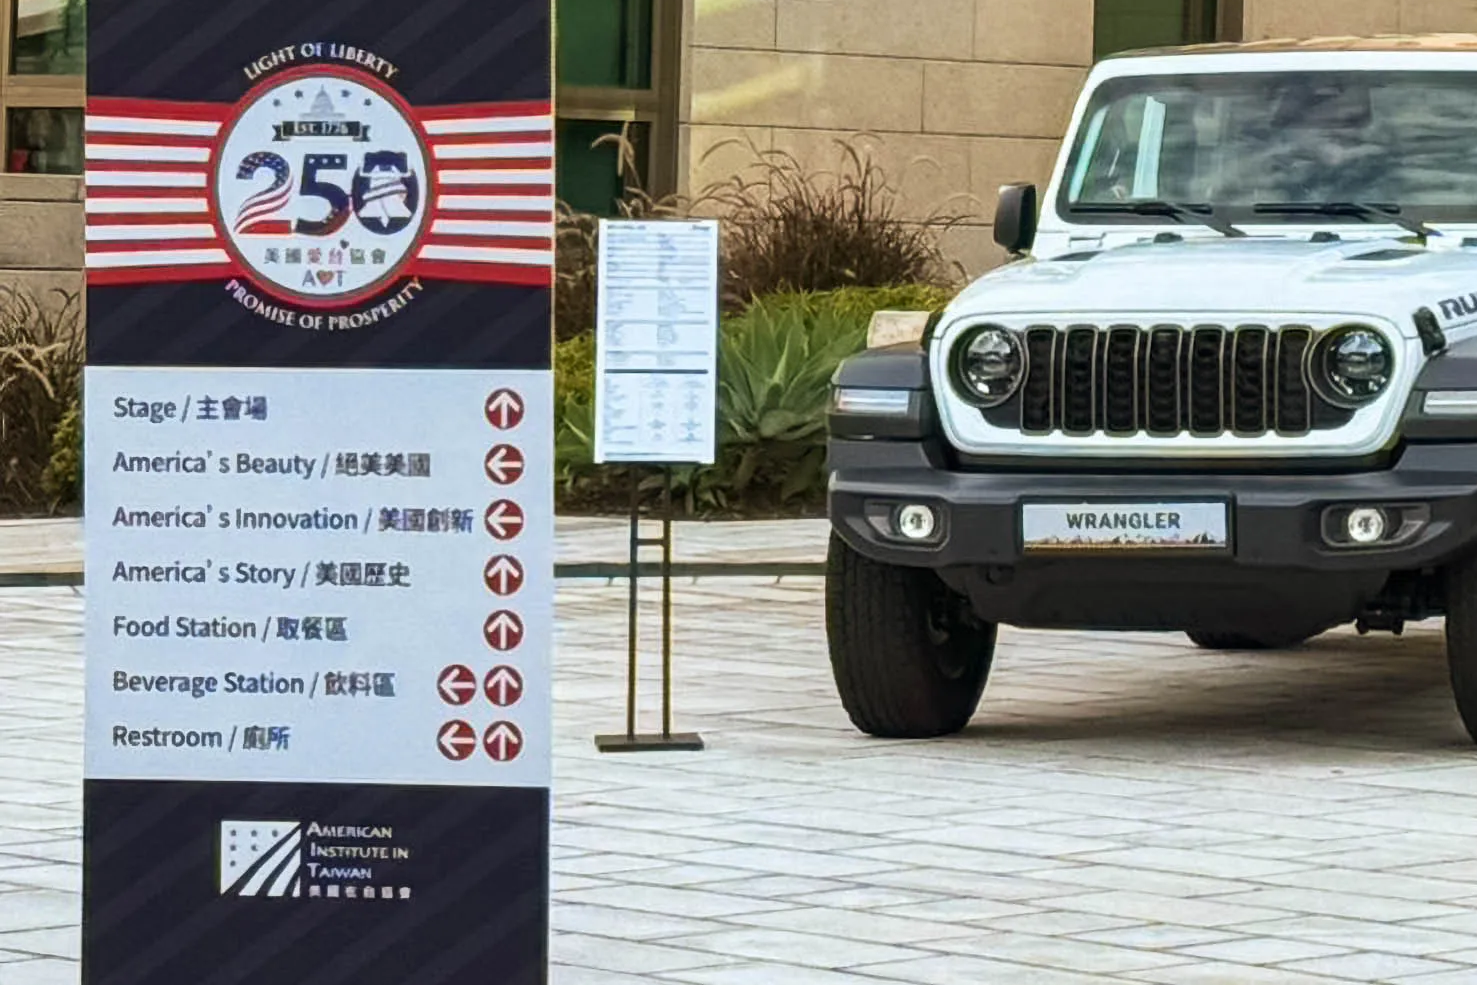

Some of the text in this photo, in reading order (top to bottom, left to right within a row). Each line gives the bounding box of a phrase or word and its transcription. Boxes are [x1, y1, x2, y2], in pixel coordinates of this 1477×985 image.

[243, 42, 399, 81] LIGHT OF LIBERTY
[233, 150, 419, 237] 250
[225, 276, 423, 330] PROMISE OF PROSPERITY
[114, 396, 177, 423] Stage
[196, 395, 268, 421] 主會場
[236, 453, 315, 479] Beauty
[236, 507, 358, 530] Innovation
[1066, 512, 1181, 529] WRANGLER
[235, 562, 296, 589] Story
[113, 616, 170, 637] Food
[175, 616, 256, 638] Station
[113, 670, 217, 697] Beverage
[224, 671, 304, 695] Station
[113, 725, 222, 748] Restroom
